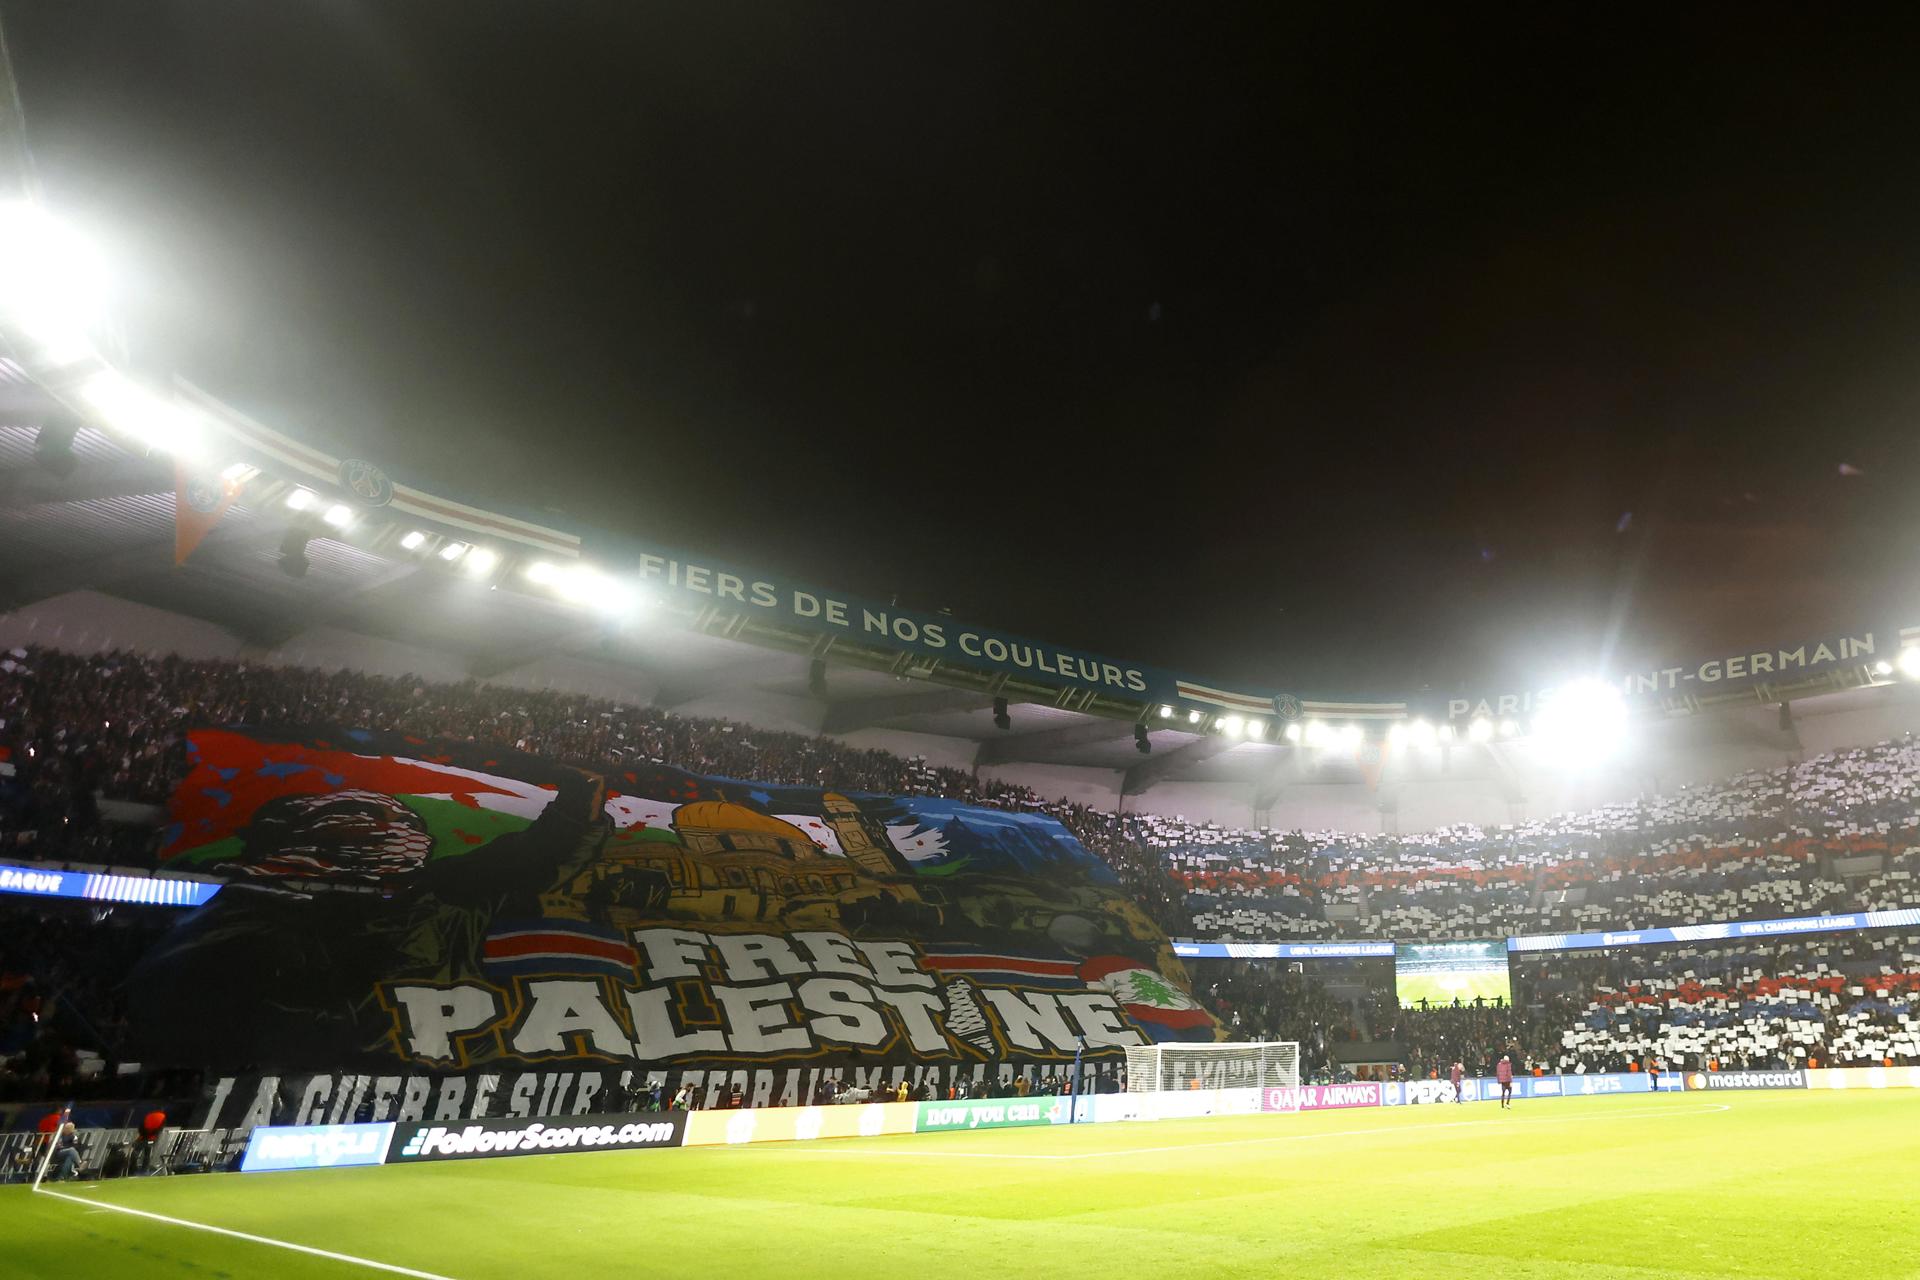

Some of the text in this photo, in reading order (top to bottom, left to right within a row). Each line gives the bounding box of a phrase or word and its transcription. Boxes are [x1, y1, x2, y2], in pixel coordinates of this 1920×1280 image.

[638, 552, 1149, 693] FIERS DE NOS COULEURS
[1607, 632, 1876, 697] INT-GERMAIN
[0, 868, 64, 893] EAGUE
[1764, 920, 1818, 931] CHAMPIONS
[1819, 917, 1856, 928] LEAGUE
[633, 927, 940, 990] FREE
[1312, 945, 1361, 955] CHAMPIONS
[1362, 945, 1393, 954] LEAGUE
[1709, 1071, 1803, 1087] mastercard
[295, 1073, 500, 1128] GUERRE
[504, 1071, 603, 1119] SUR
[1321, 1086, 1378, 1107] AIRWAYS
[1405, 1079, 1458, 1105] PEPS
[926, 1103, 1041, 1128] now you can
[420, 1121, 675, 1155] FollowScores.com
